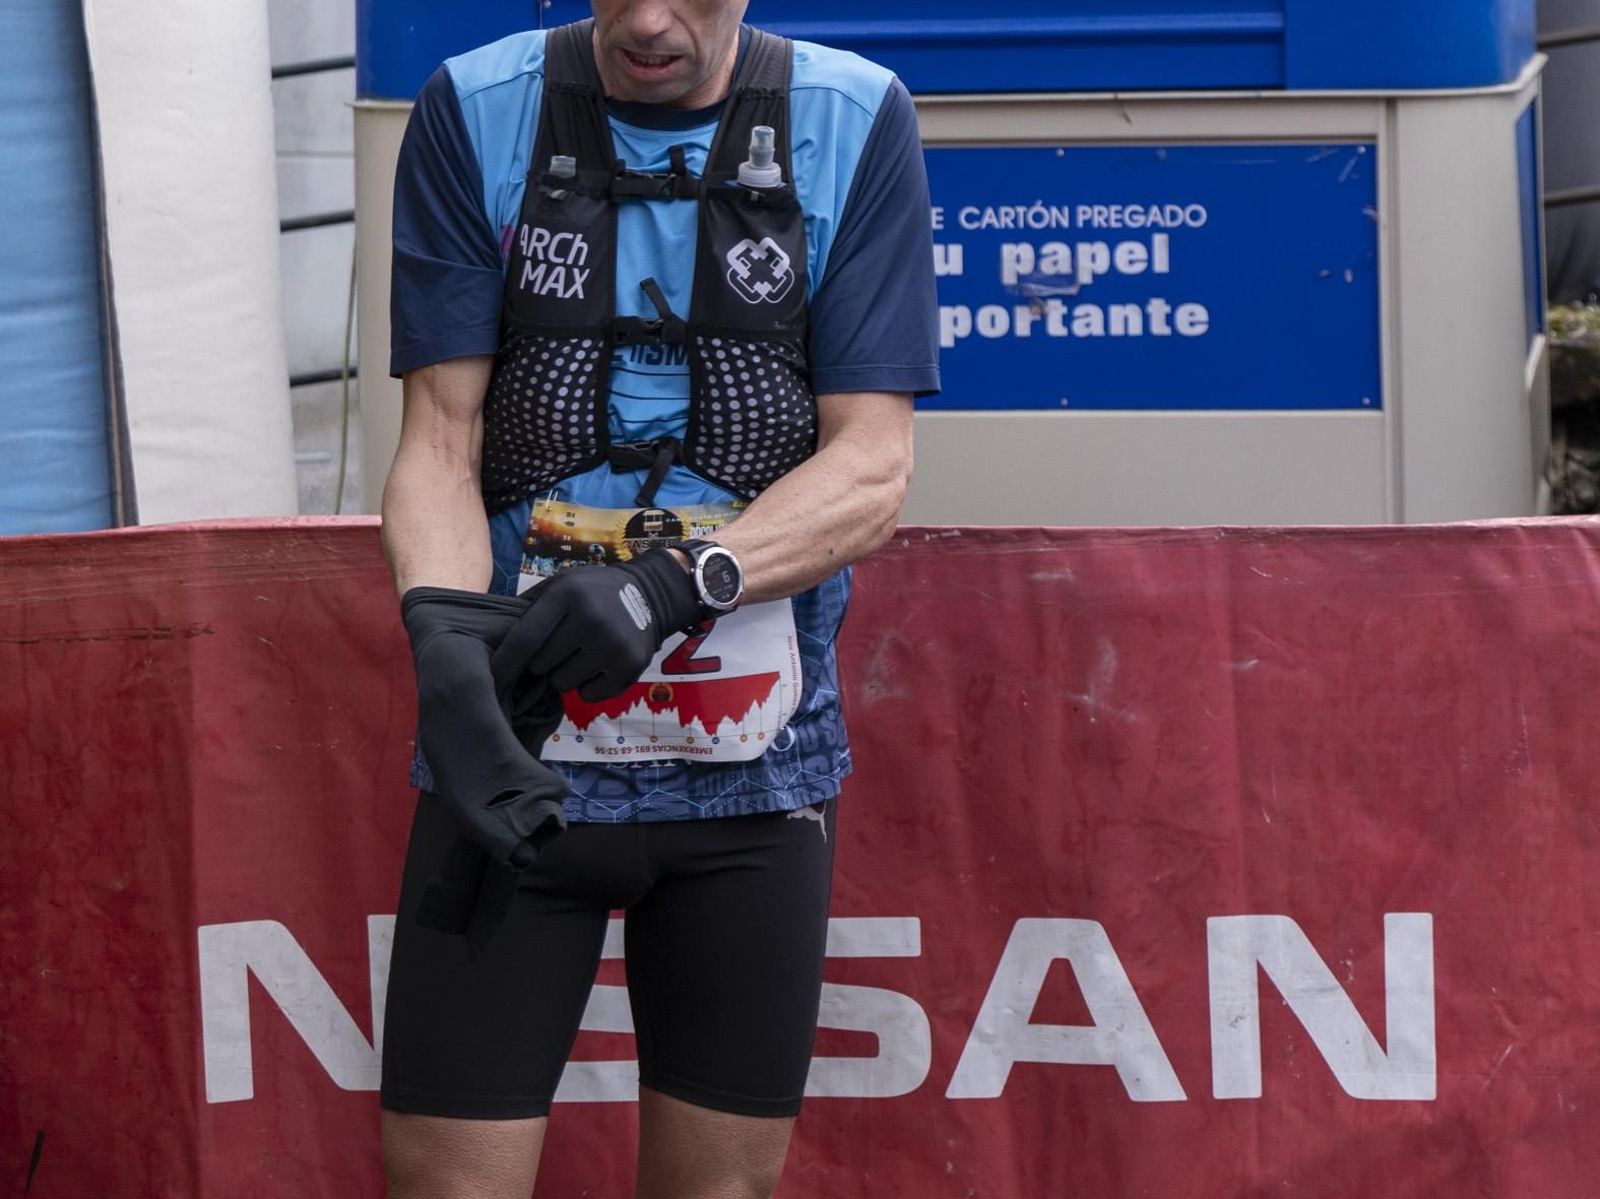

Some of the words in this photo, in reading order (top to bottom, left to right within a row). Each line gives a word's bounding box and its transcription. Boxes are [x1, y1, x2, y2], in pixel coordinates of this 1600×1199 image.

[959, 200, 1070, 229] CARTÓN
[1076, 204, 1207, 228] PREGADO
[520, 259, 591, 299] MAX
[933, 243, 963, 276] u
[1001, 233, 1169, 285] papel
[939, 297, 1210, 348] portante
[652, 744, 713, 755] EMERXENCIAS
